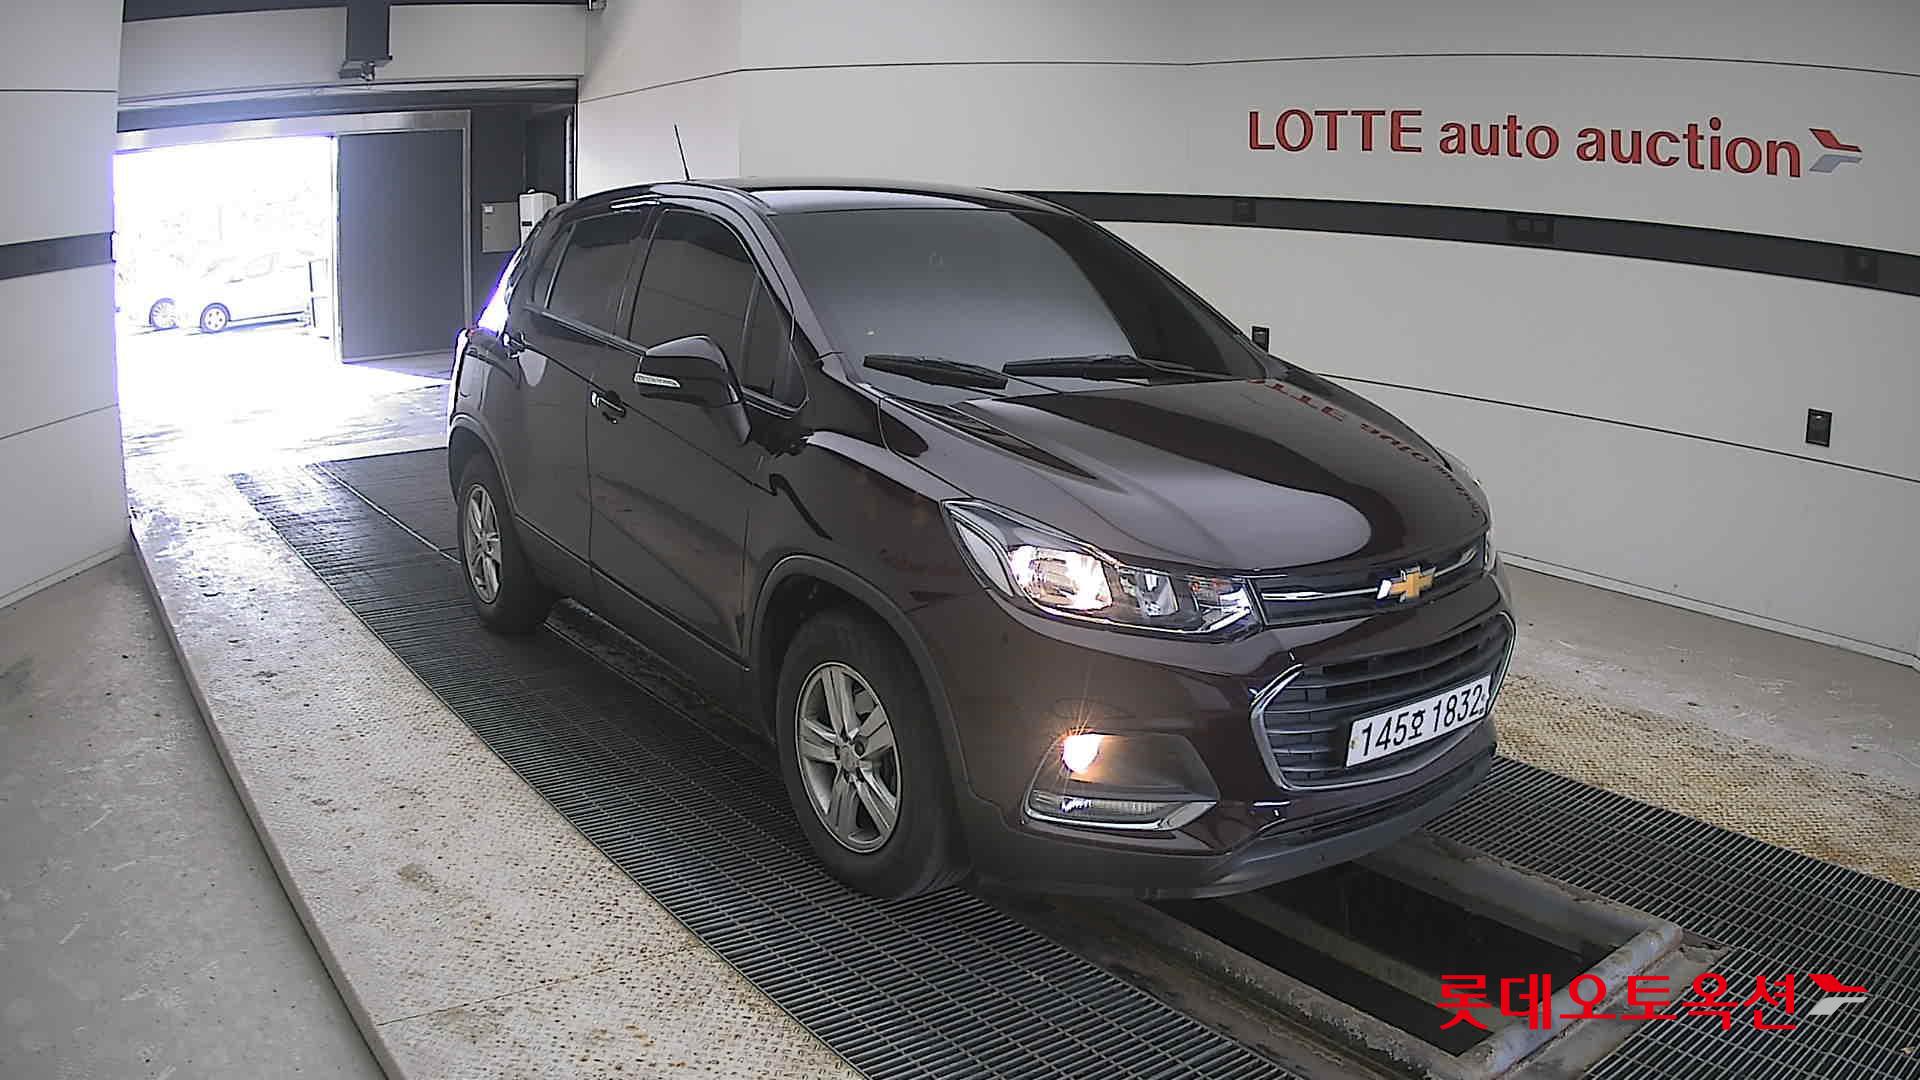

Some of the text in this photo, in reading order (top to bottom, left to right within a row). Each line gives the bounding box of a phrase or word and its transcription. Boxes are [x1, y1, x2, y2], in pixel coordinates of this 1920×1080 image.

[1248, 109, 1803, 178] LOTTE auto auction
[1433, 684, 1484, 733] 1832
